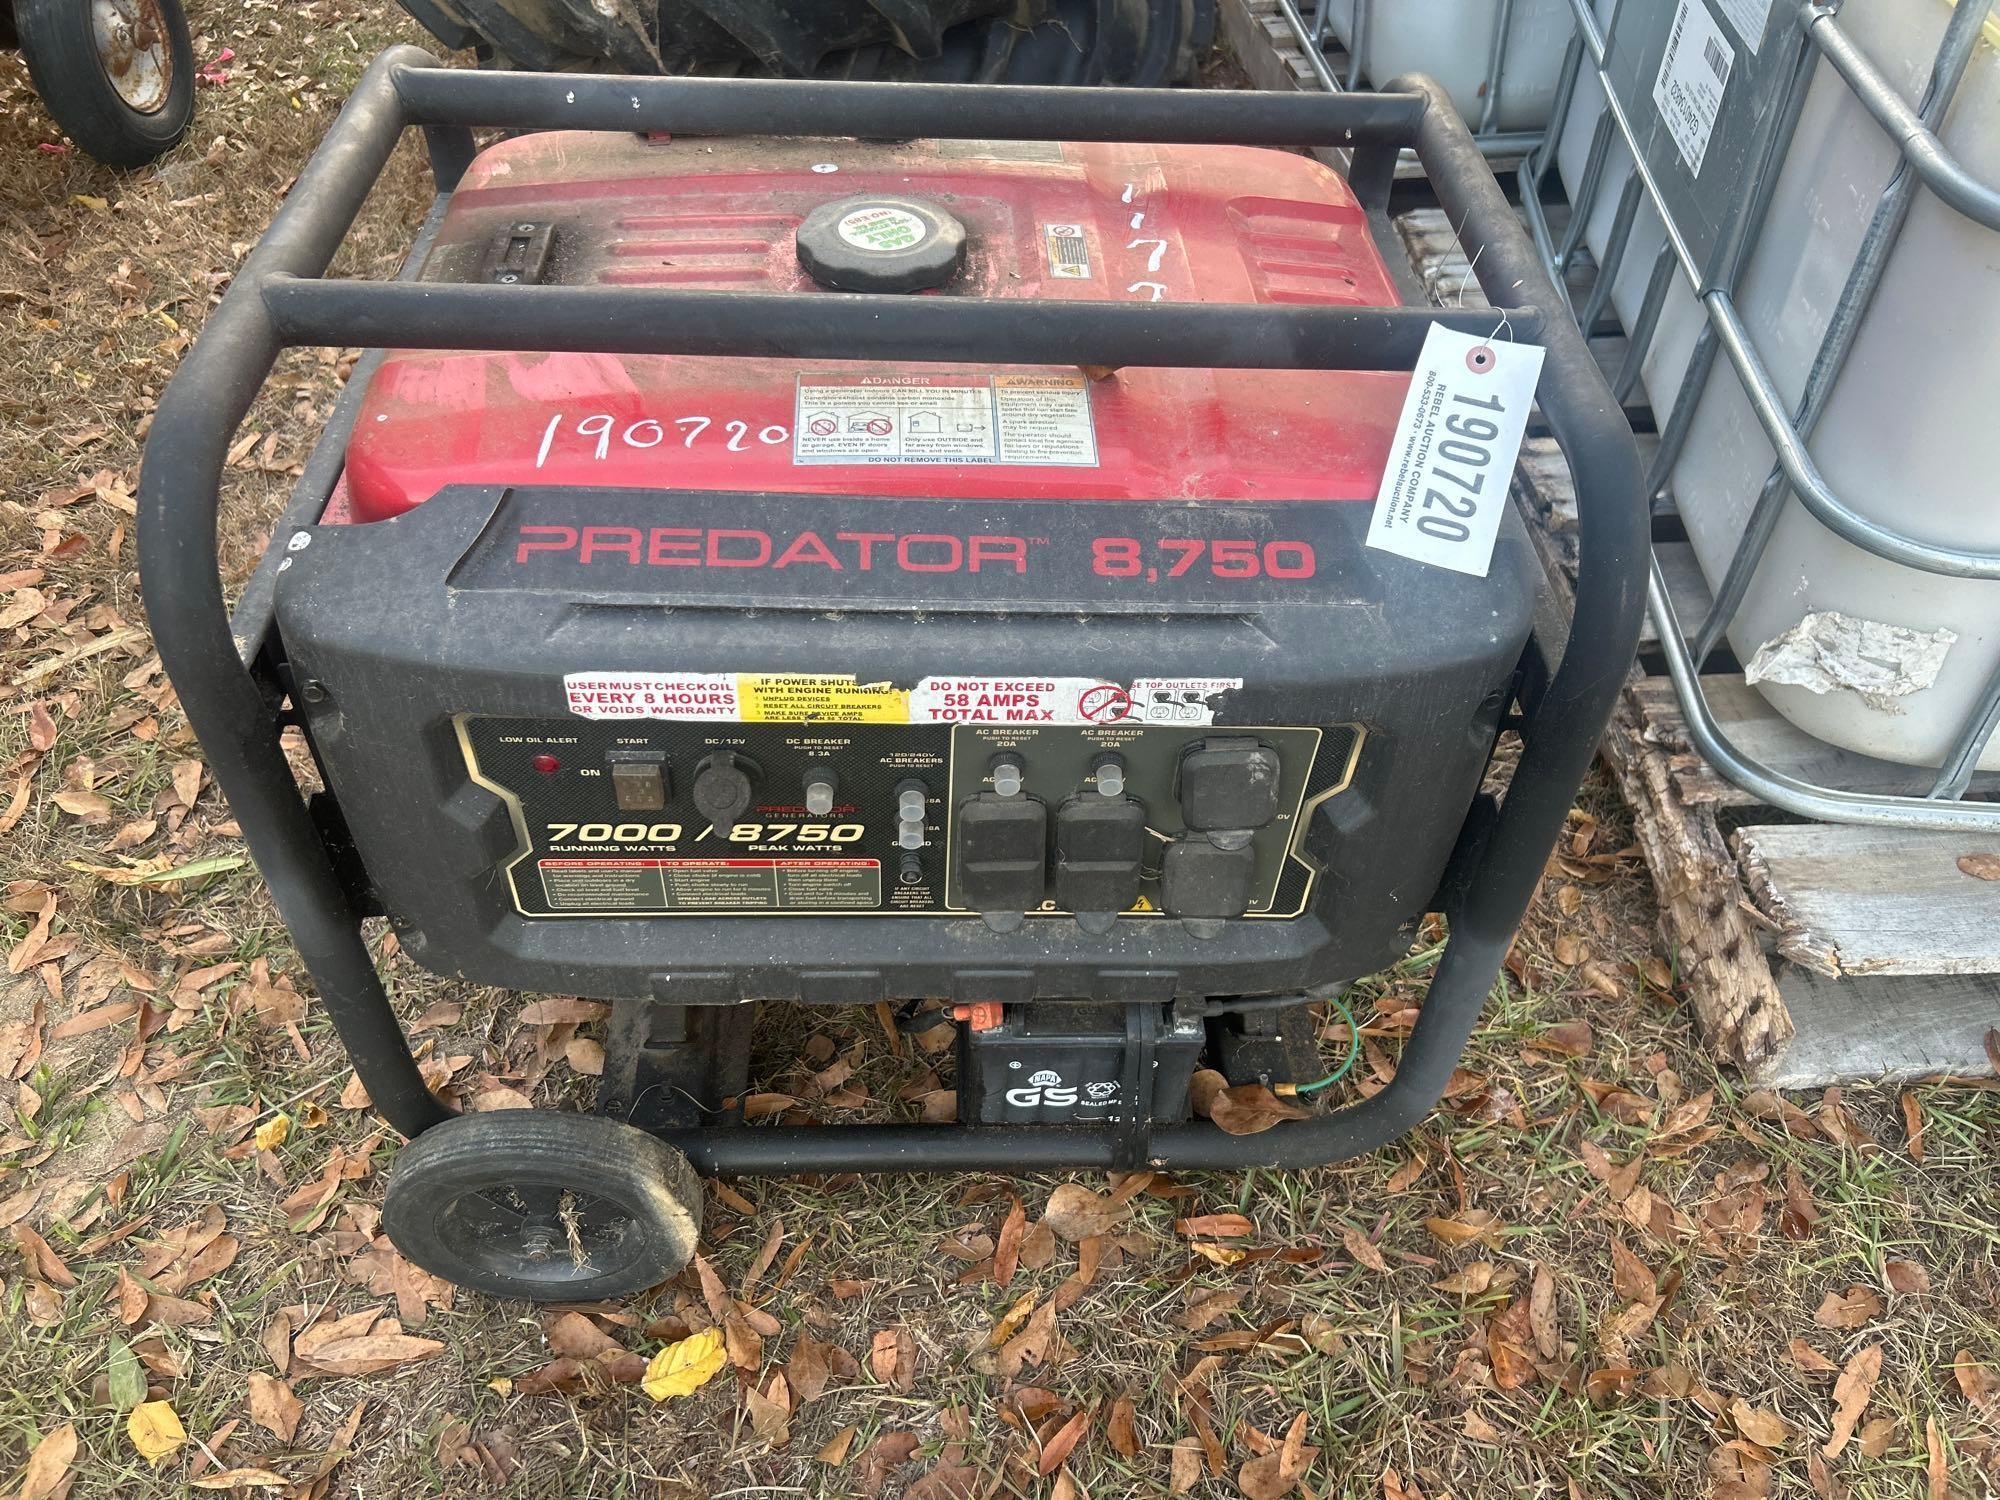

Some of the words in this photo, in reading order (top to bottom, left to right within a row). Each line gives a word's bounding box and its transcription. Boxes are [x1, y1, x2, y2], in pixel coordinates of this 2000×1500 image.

[873, 377, 930, 386] DANGER
[1414, 370, 1437, 430] 800-533-0673
[1430, 383, 1447, 423] REBEL
[536, 414, 790, 468] 190720
[1415, 420, 1436, 473] AUCTION
[1416, 394, 1506, 543] 190720
[1384, 436, 1416, 529] www.rebelauction.net
[1399, 470, 1422, 524] COMPANY
[1092, 537, 1316, 581] 8,750
[567, 682, 606, 690] USER
[610, 682, 651, 690] MUST
[654, 683, 707, 691] CHECK
[709, 683, 735, 691] OIL
[775, 678, 817, 686] POWER
[930, 682, 952, 691] DO
[957, 682, 989, 691] NOT
[994, 682, 1056, 692] EXCEED
[569, 692, 636, 704] EVERY
[644, 693, 656, 704] 8
[664, 693, 735, 705] HOURS
[944, 693, 970, 707] 58
[977, 693, 1040, 708] AMPS
[572, 705, 593, 713] OR
[598, 705, 645, 714] VOIDS
[651, 706, 737, 715] WARRANTY
[928, 708, 999, 720] TOTAL
[1006, 709, 1055, 721] MAX
[546, 823, 682, 842] 7000
[694, 823, 714, 842] /
[728, 823, 865, 842] 8750
[549, 844, 620, 852] RUNNING
[1033, 1073, 1057, 1084] NAPA
[1005, 1086, 1078, 1107] GS
[1080, 1099, 1107, 1107] SEALED
